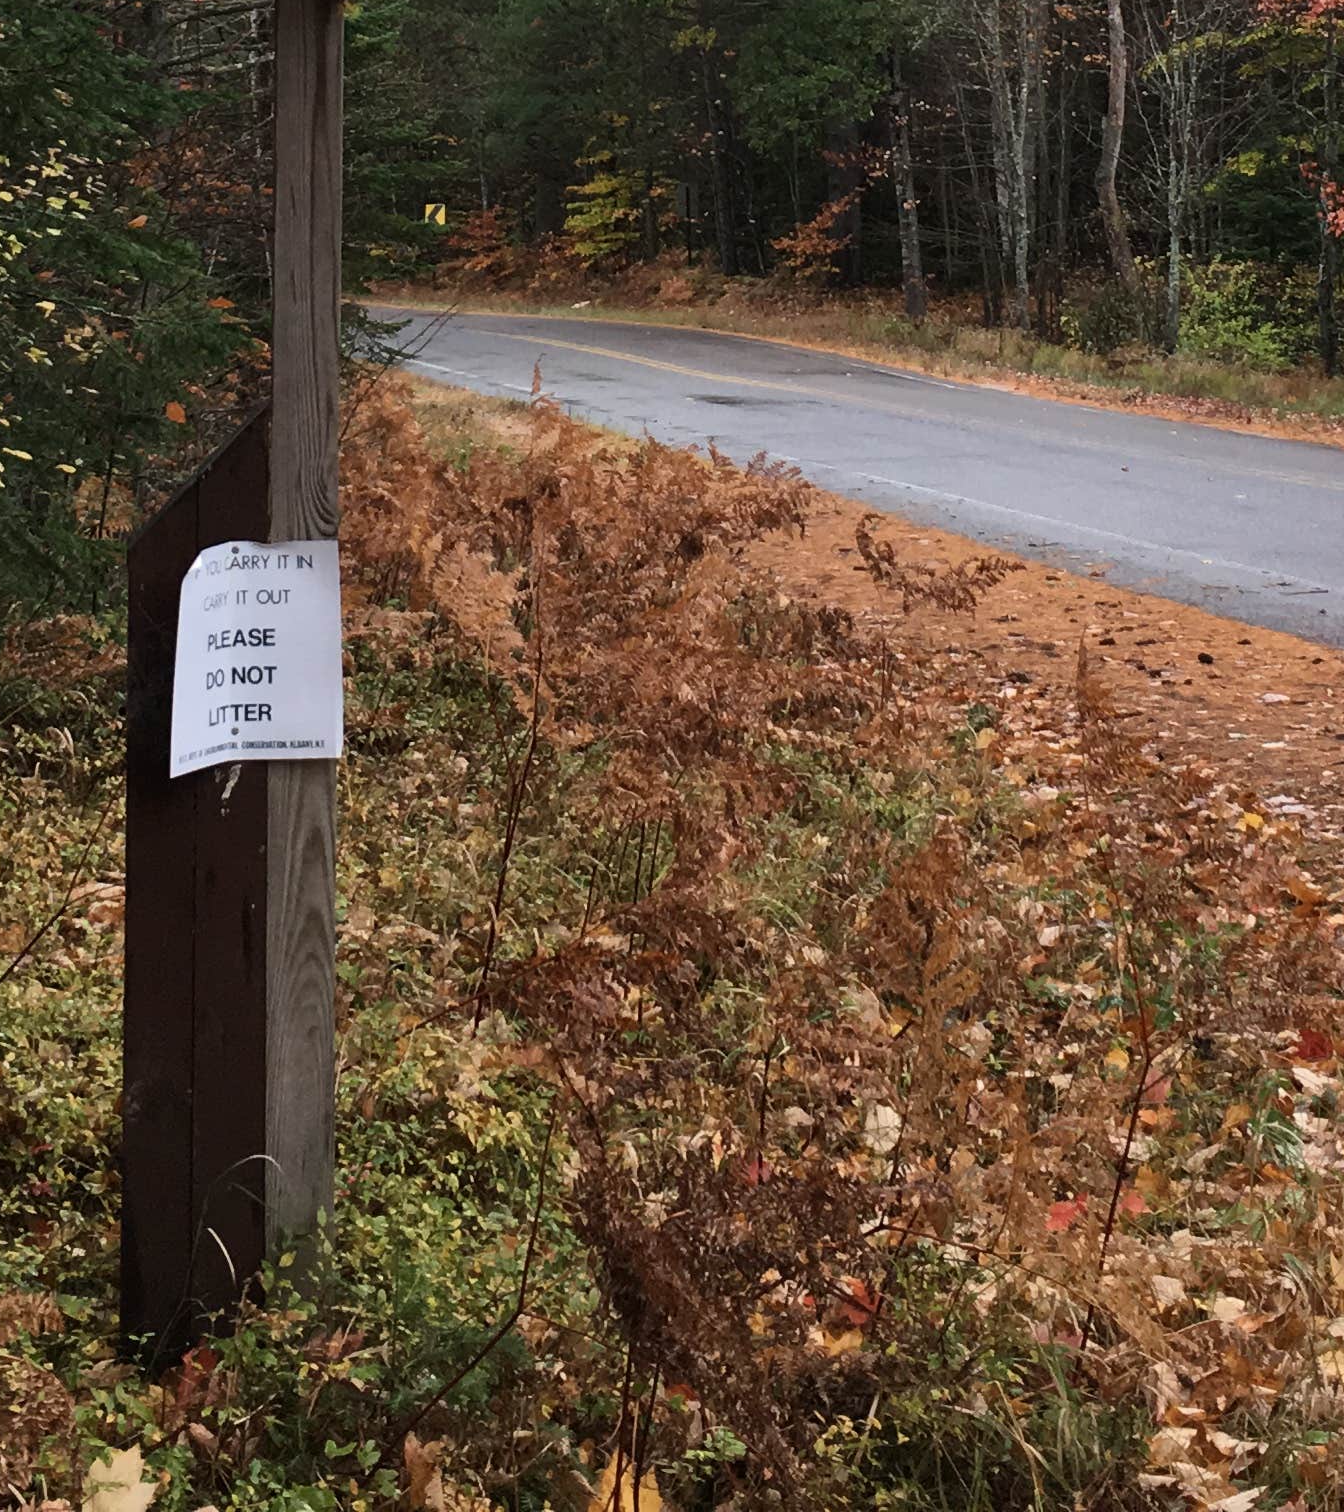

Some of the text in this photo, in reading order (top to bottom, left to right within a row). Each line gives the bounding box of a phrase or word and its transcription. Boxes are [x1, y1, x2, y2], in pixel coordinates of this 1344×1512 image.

[225, 555, 270, 570] CARRY
[277, 555, 289, 569] IT
[297, 555, 313, 568] IN
[204, 589, 291, 611] CARRY IT OUT
[208, 629, 276, 652] PLEASE
[207, 666, 277, 689] DO NOT
[209, 704, 272, 727] LITTER
